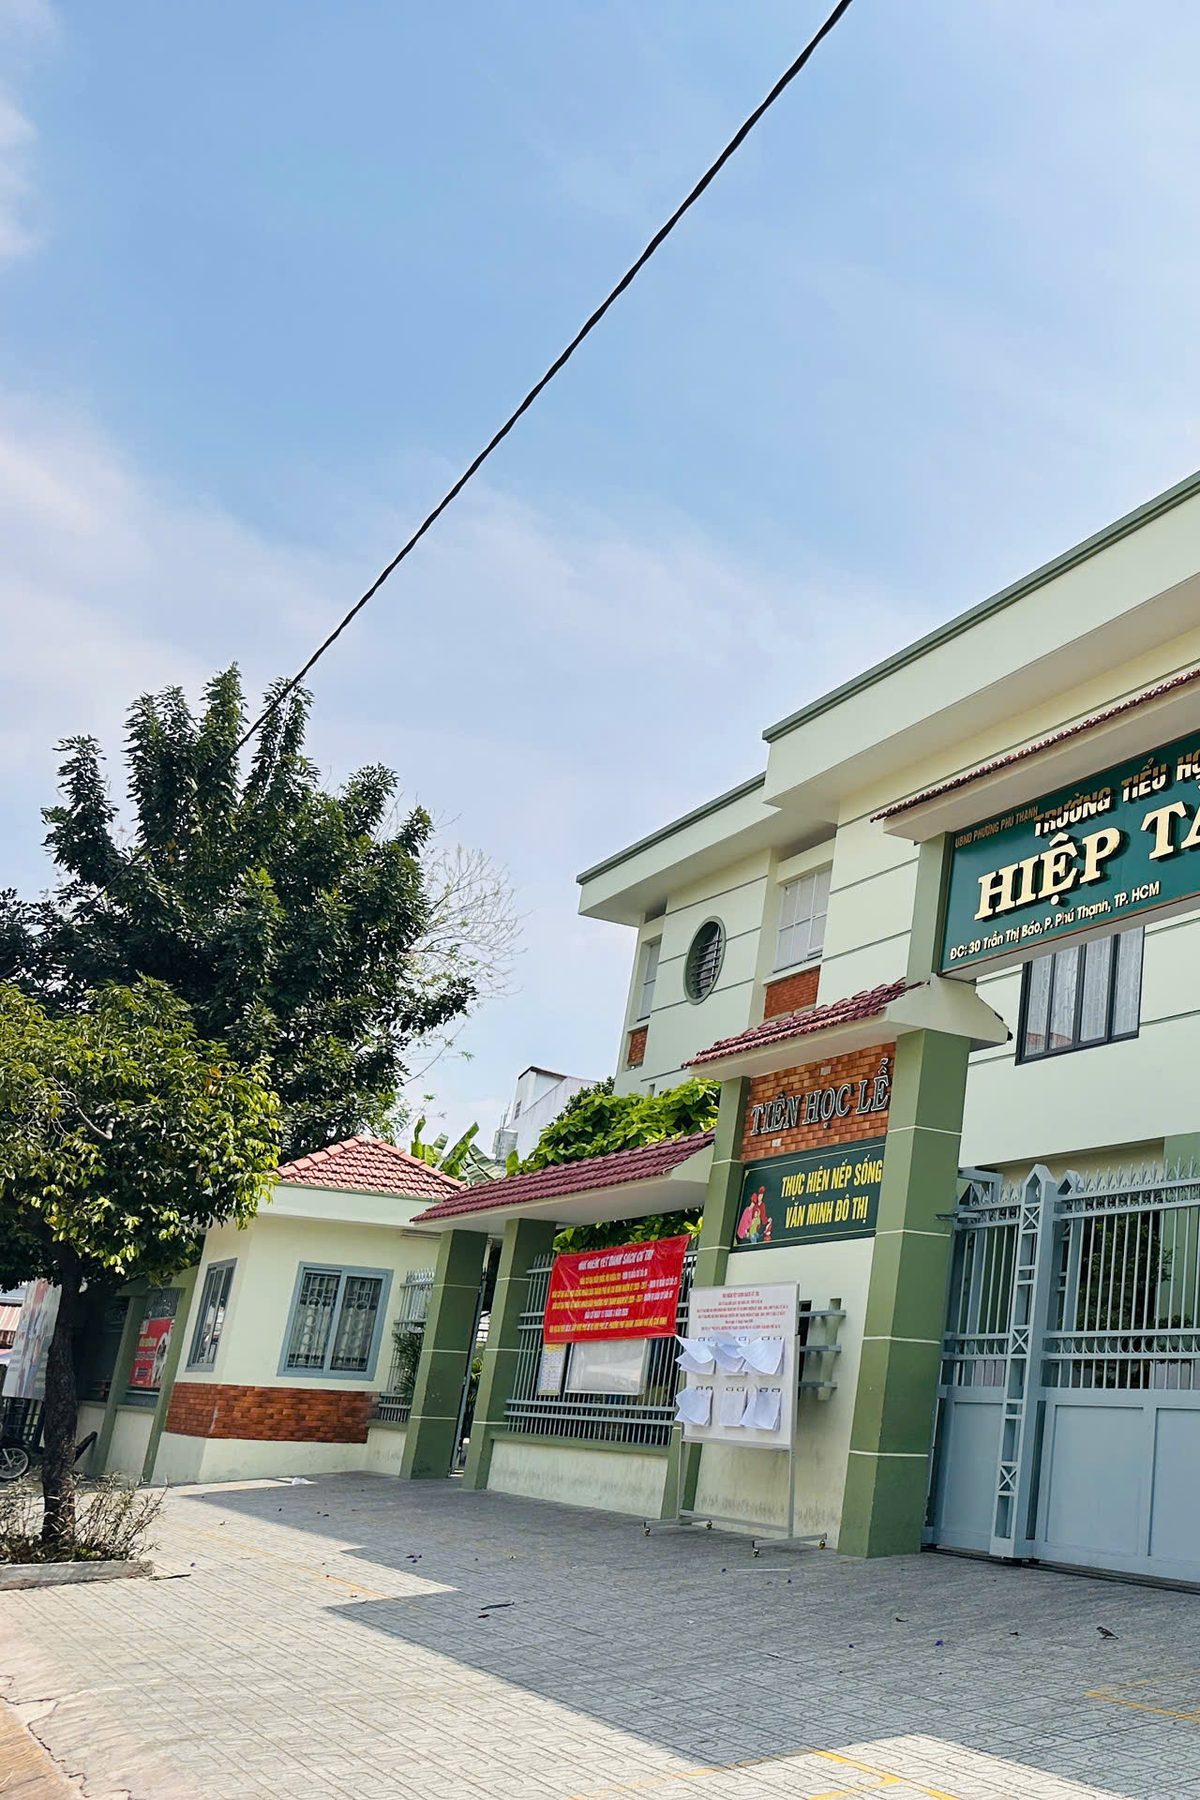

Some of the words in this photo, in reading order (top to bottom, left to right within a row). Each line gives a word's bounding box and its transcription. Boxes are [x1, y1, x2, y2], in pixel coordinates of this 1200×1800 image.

[1034, 787, 1112, 837] TRƯỜNG
[1121, 758, 1168, 802] TIỂU
[973, 828, 1121, 920] HIỆP
[950, 947, 967, 960] ĐC:
[968, 939, 981, 954] 30
[983, 930, 1003, 949] Trần
[1005, 930, 1020, 944] Thị
[1021, 920, 1042, 937] Báo,
[1044, 919, 1053, 931] P.
[1055, 910, 1075, 927] Phú
[1077, 899, 1111, 919] Thạnh,
[1114, 892, 1129, 907] TP.
[1131, 881, 1160, 903] HCM
[751, 1090, 800, 1136] TIÊN
[802, 1083, 851, 1129] HỌC
[856, 1057, 890, 1115] LỄ
[781, 1172, 804, 1201] THỰC
[806, 1166, 830, 1197] HIỆN
[830, 1158, 851, 1190] NẾP
[853, 1154, 883, 1187] SỐNG
[785, 1201, 805, 1229] VĂN
[807, 1202, 833, 1226] MINH
[835, 1194, 850, 1222] ĐÔ
[851, 1196, 869, 1223] THỊ
